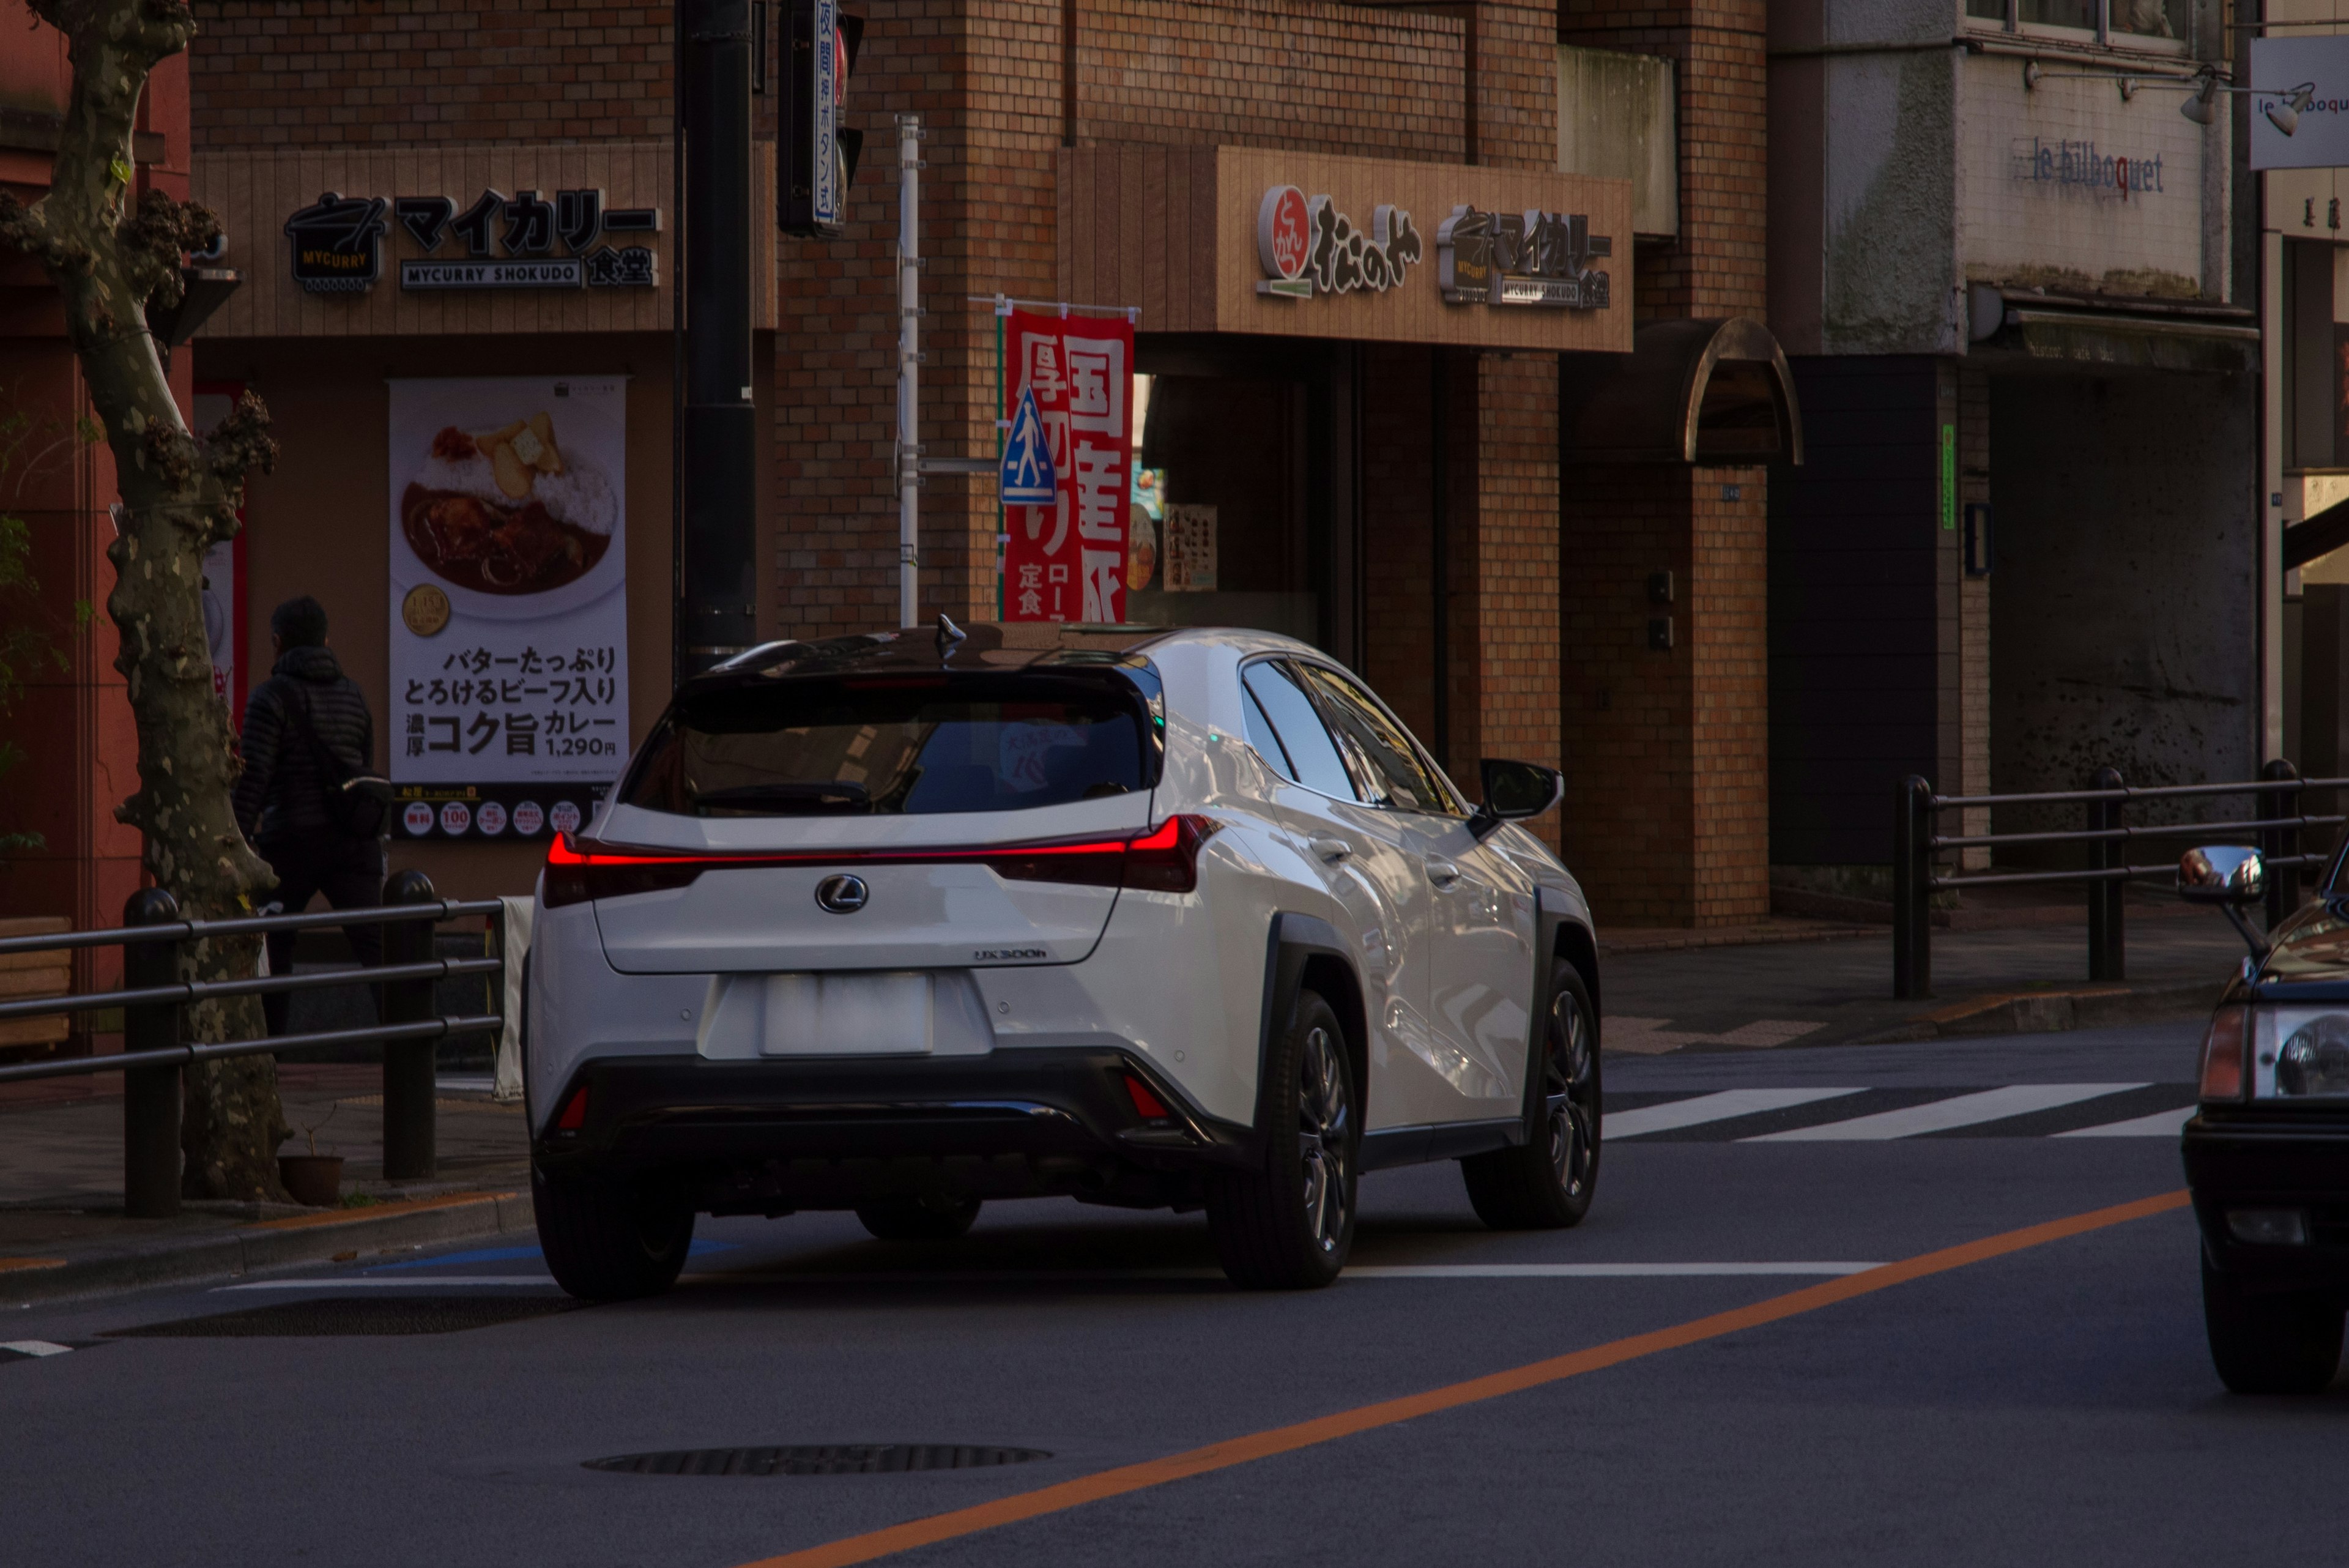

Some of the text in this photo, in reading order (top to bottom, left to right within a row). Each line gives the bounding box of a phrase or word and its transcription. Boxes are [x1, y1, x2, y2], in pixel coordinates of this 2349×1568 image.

[2034, 136, 2164, 201] le bilboquet
[395, 188, 657, 255] マイカリー
[1500, 209, 1611, 273] マイカリー
[303, 251, 366, 270] MYCURRY
[408, 266, 574, 281] MYCURRY SHOKUDO
[585, 247, 653, 286] 食堂
[1458, 261, 1487, 280] MYCURRY
[1504, 283, 1576, 299] MYCURRY SHOKUDO
[1018, 562, 1042, 615] 定食
[443, 646, 615, 674] バターたっぷり
[405, 677, 615, 705] とろけるビーフ入り
[406, 713, 425, 757] 濃厚
[429, 710, 615, 755] コク旨 カレー
[546, 738, 616, 757] 1,290円
[443, 810, 468, 823] 100
